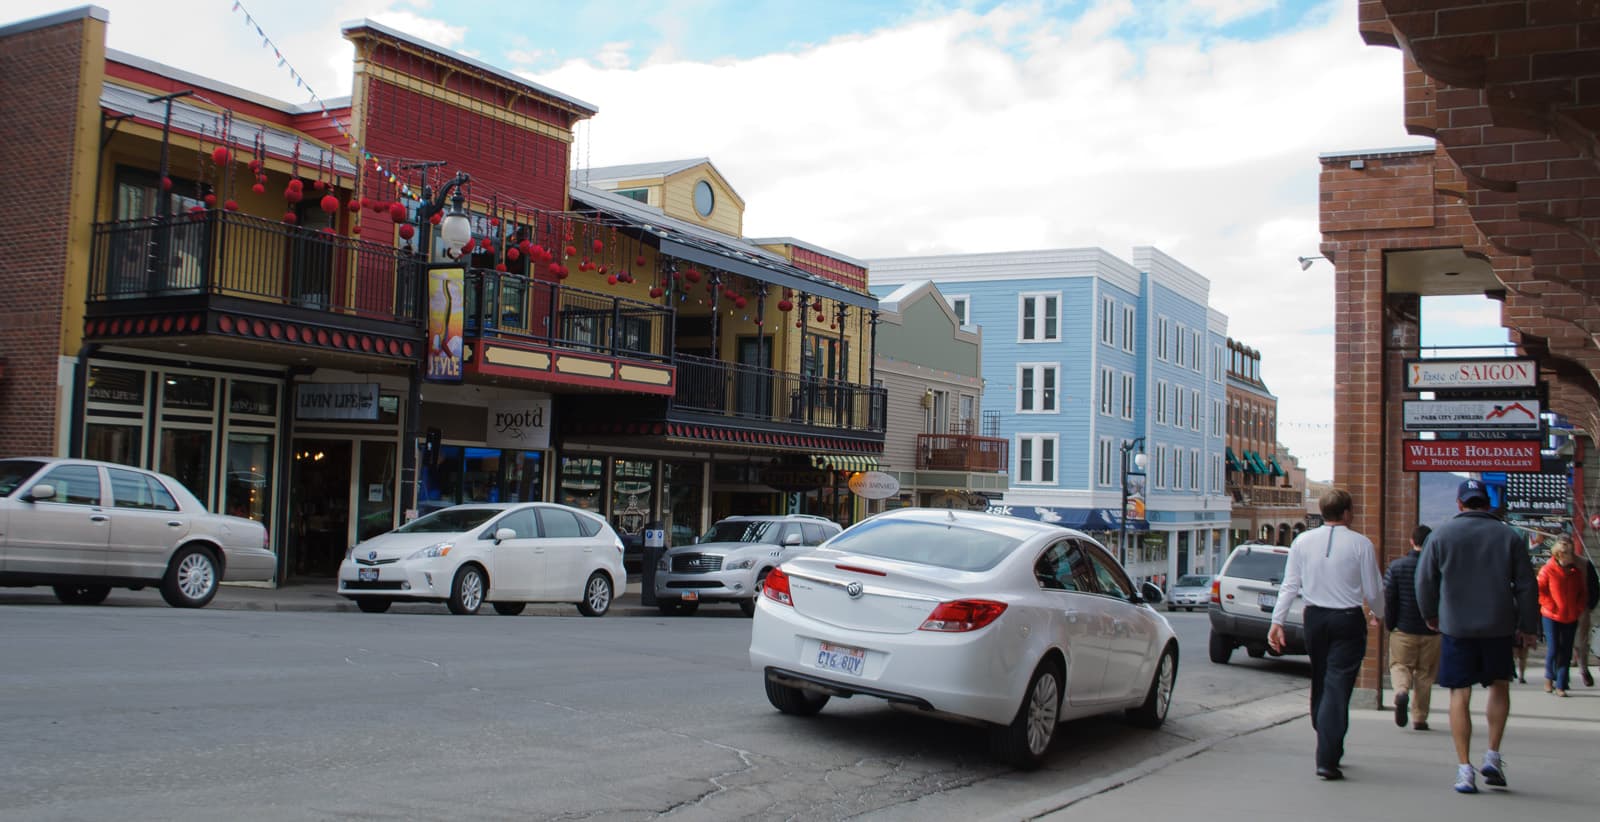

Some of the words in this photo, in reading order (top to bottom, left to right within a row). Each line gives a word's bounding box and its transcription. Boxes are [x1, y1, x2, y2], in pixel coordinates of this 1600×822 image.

[428, 356, 460, 376] STYLE
[1423, 370, 1447, 382] Taste
[1449, 371, 1459, 381] of
[1460, 364, 1528, 381] SAIGON
[335, 392, 358, 408] LIFE
[1467, 431, 1507, 439] RENTALS
[1410, 445, 1459, 457] WILLIE
[1465, 445, 1533, 457] HOLDMAN
[1507, 498, 1530, 511] yuki
[1532, 499, 1566, 510] arashi
[818, 651, 839, 668] C16
